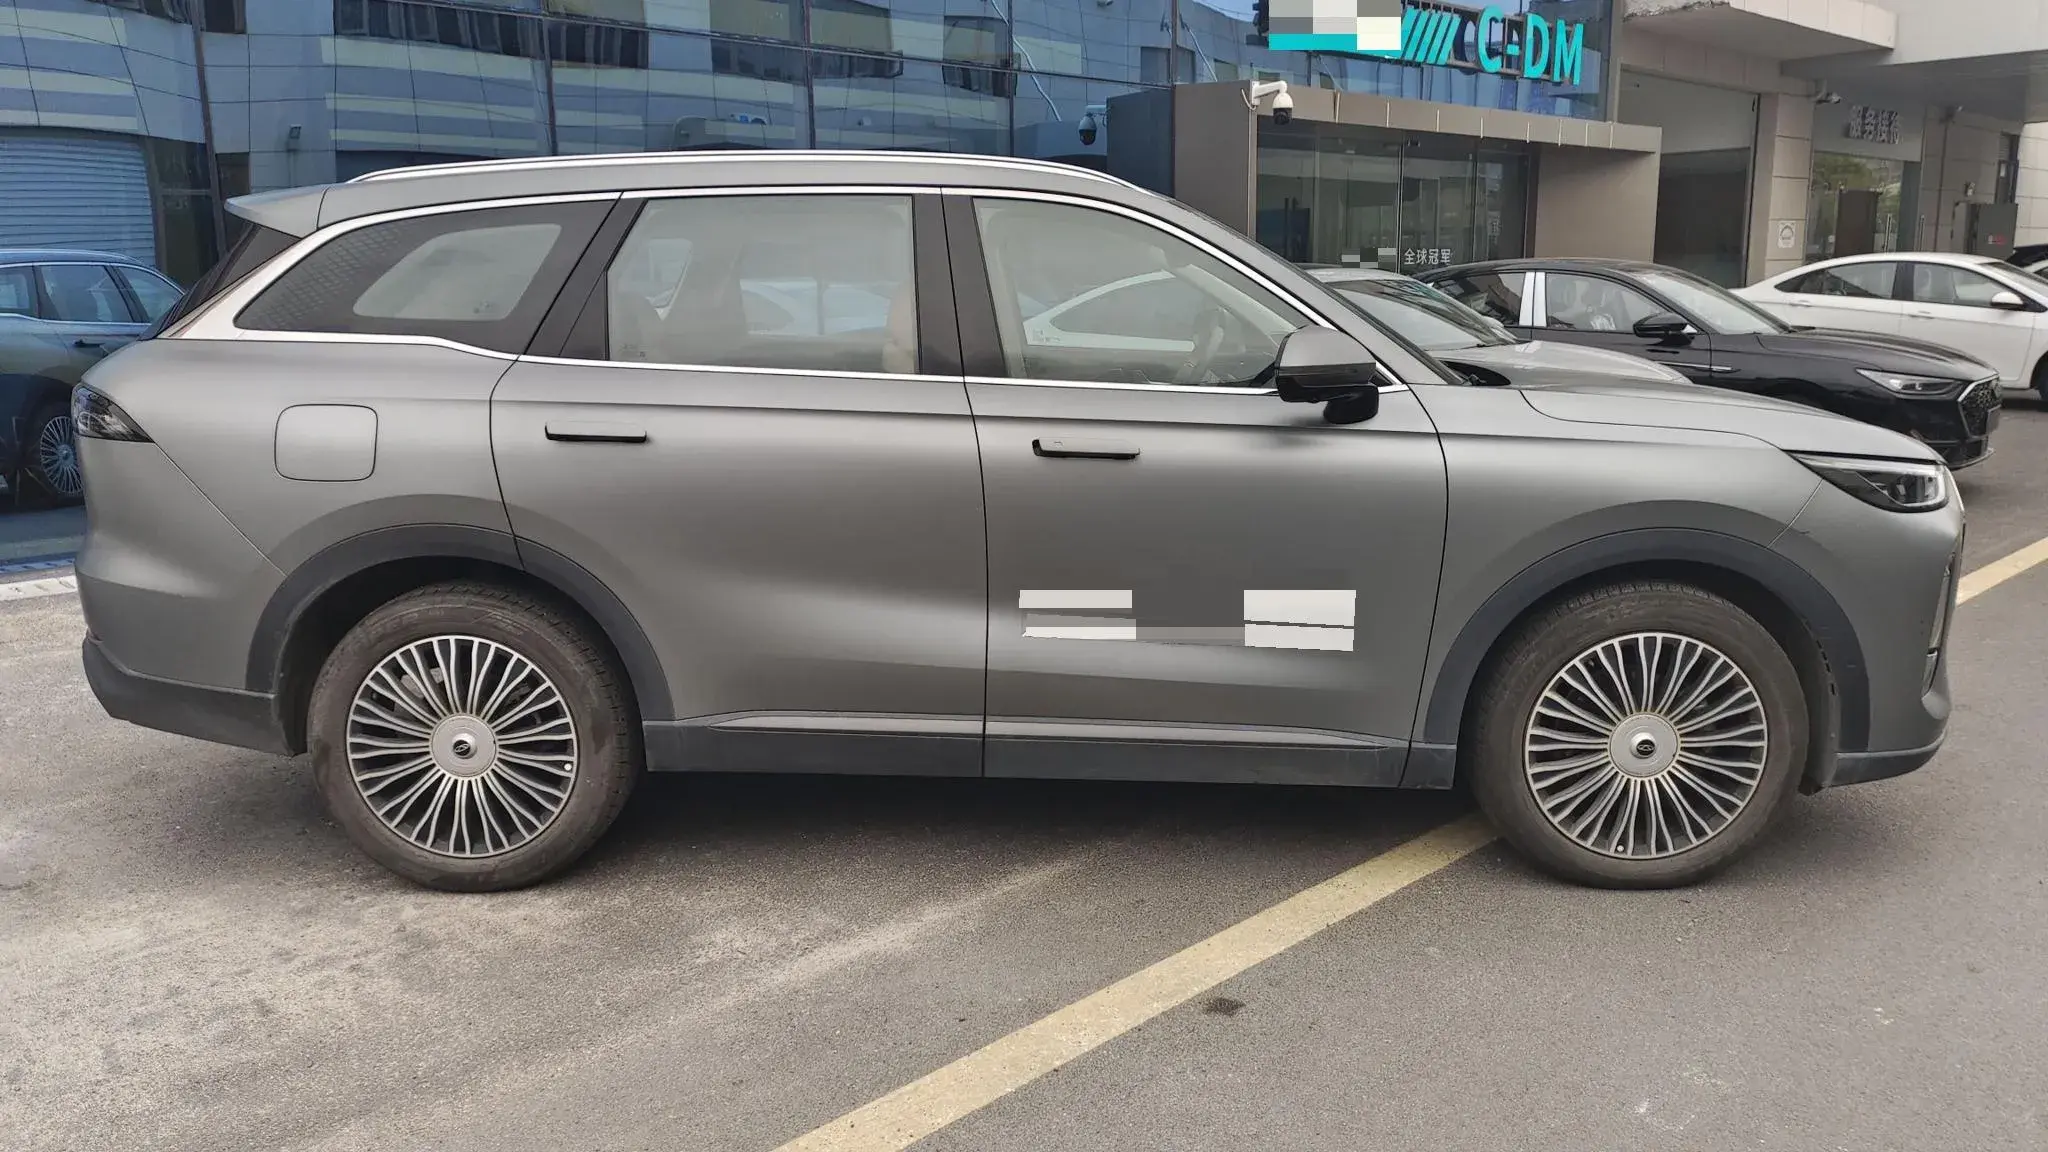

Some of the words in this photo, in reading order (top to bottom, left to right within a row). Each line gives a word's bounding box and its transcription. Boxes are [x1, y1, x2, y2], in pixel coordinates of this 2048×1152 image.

[1478, 5, 1584, 86] C-DM
[1404, 248, 1451, 265] 全球冠军
